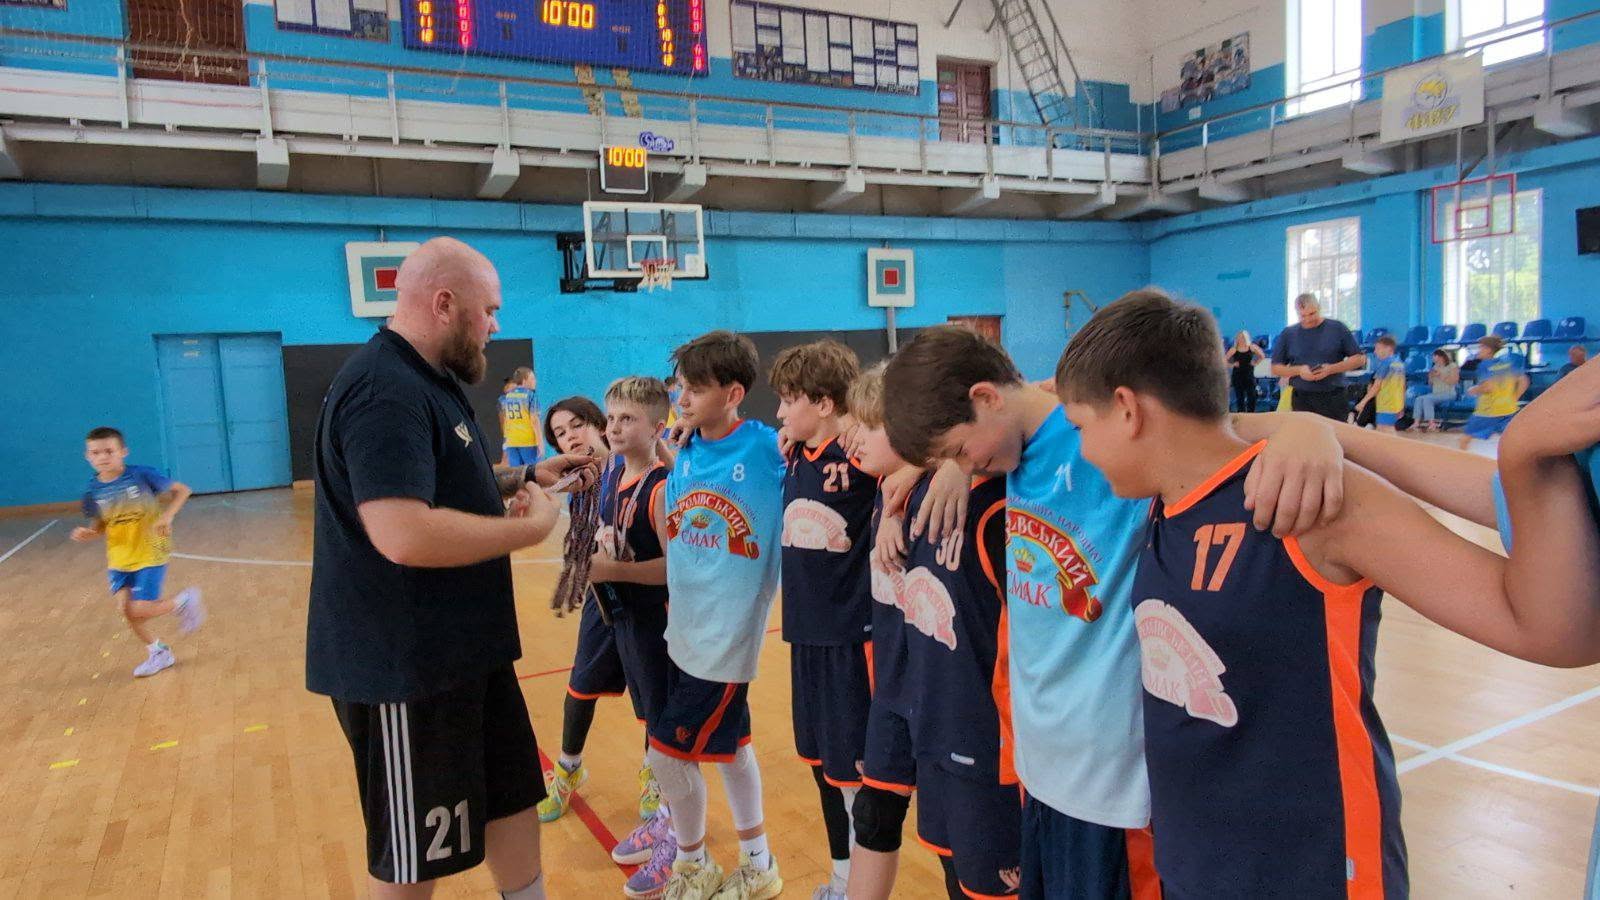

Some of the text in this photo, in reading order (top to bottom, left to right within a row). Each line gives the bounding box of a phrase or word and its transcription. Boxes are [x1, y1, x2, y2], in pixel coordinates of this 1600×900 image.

[732, 463, 745, 482] 8
[822, 462, 849, 492] 21
[681, 529, 723, 550] СМАК
[1190, 522, 1246, 591] 17
[425, 798, 471, 862] 21
